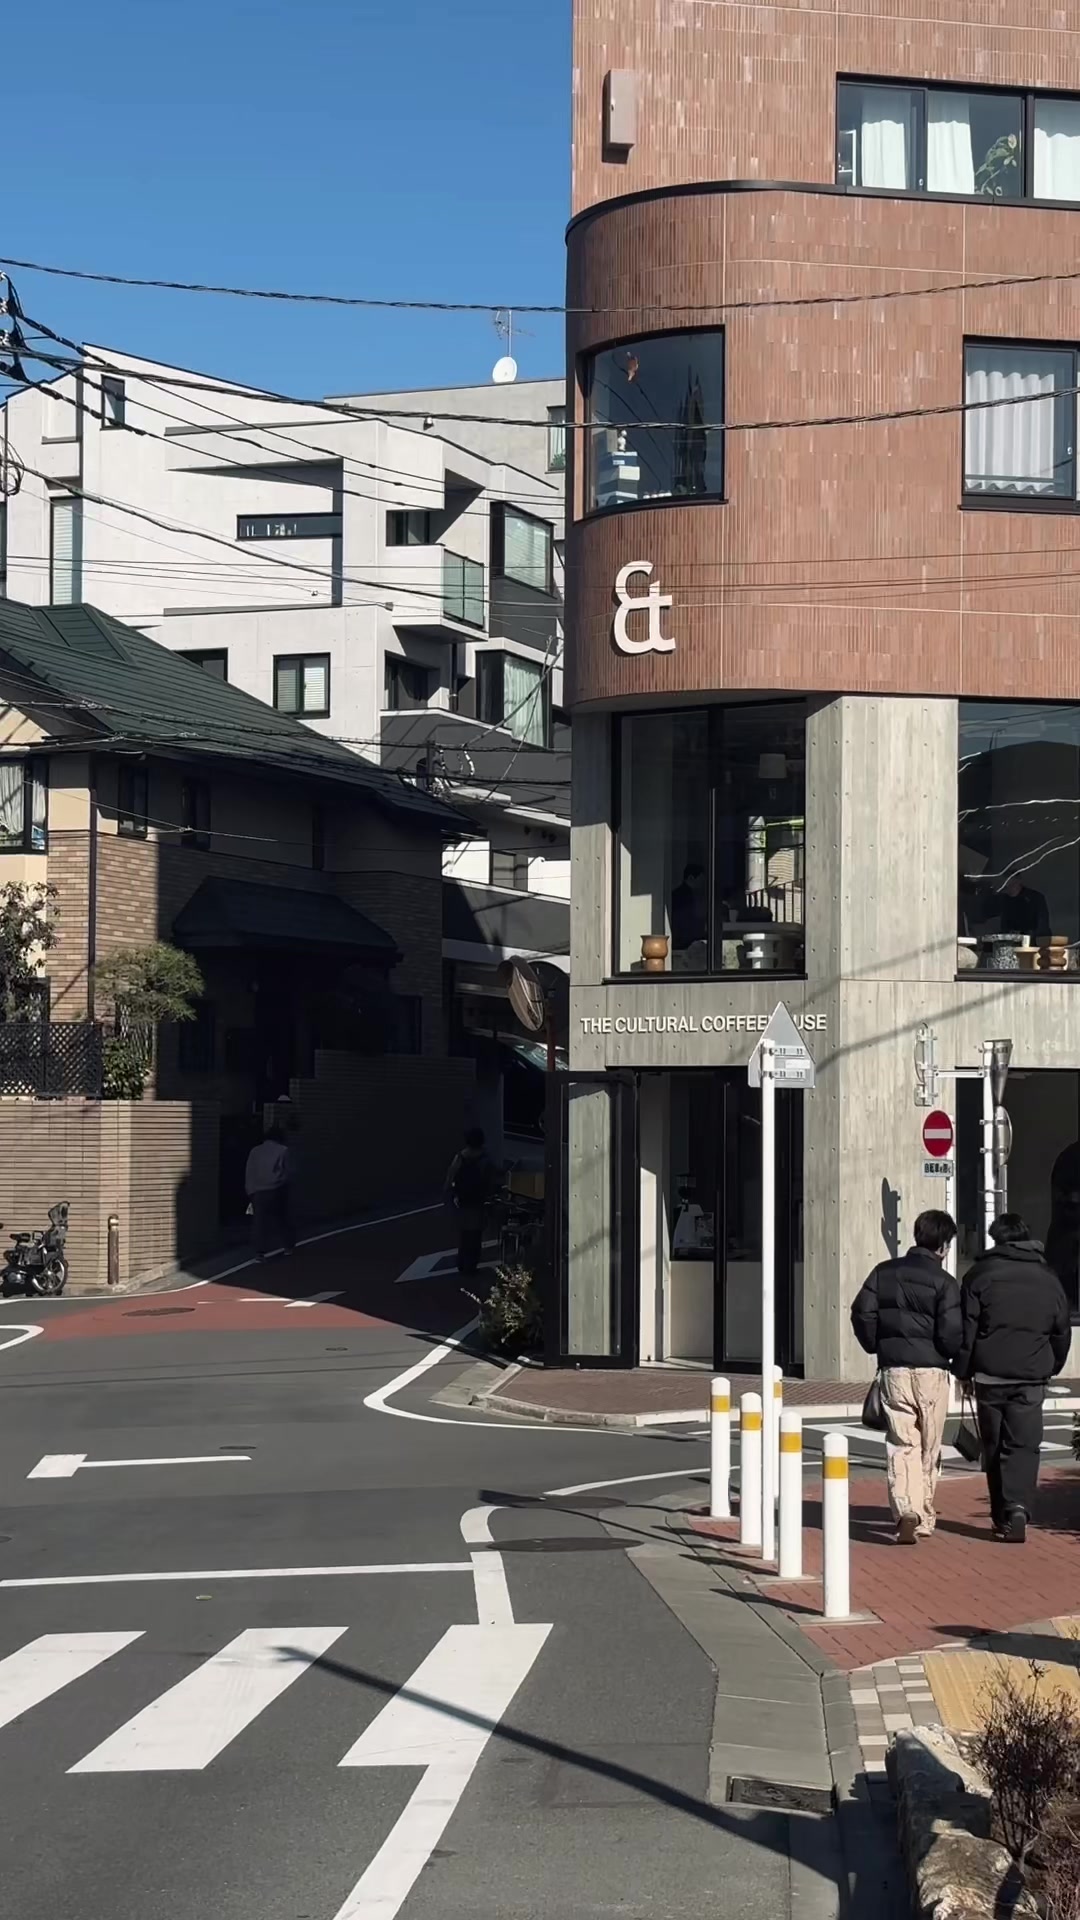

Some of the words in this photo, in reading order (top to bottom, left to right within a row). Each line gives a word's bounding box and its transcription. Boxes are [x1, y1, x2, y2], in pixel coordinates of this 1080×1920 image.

[614, 560, 676, 654] &
[580, 1017, 612, 1033] THE
[615, 1016, 699, 1033] CULTURAL
[701, 1013, 827, 1032] COFFEEUSE
